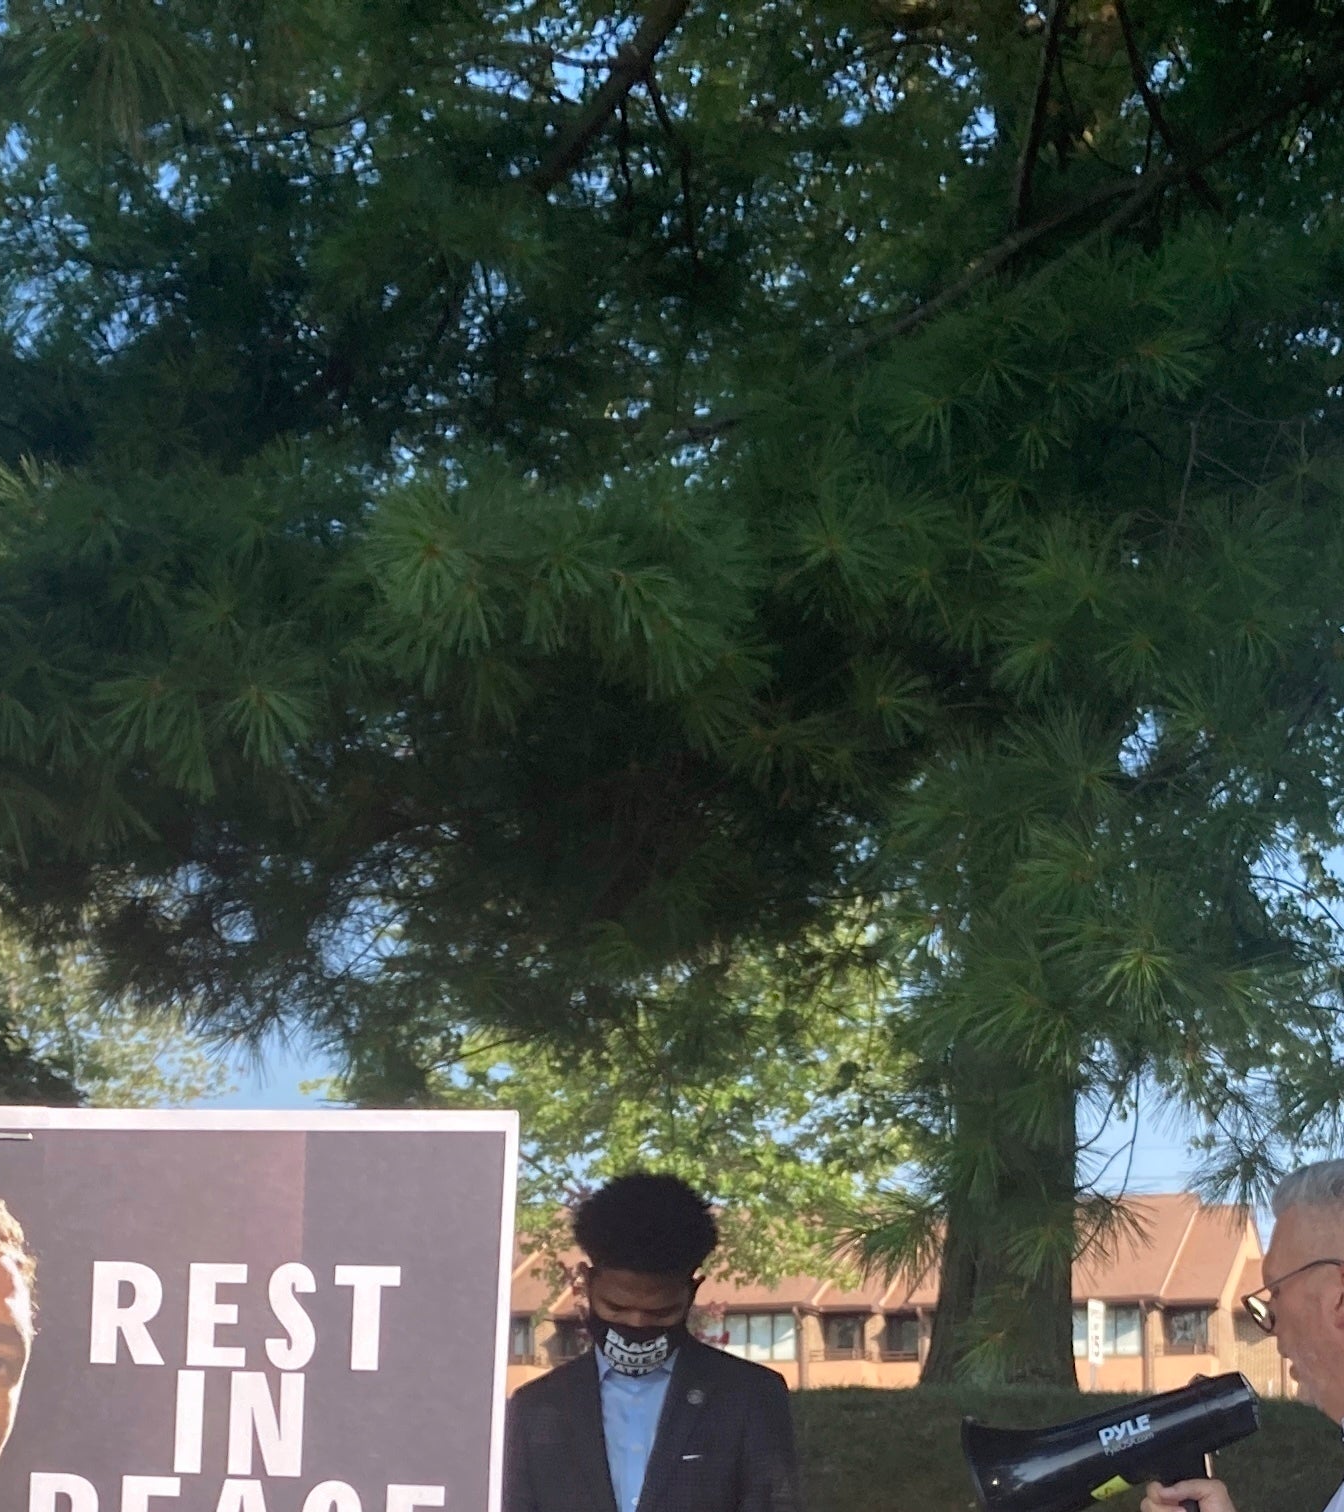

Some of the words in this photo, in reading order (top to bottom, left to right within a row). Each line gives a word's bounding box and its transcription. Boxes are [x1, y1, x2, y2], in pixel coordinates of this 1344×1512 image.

[89, 1260, 401, 1372] REST
[174, 1369, 305, 1478] IN
[1098, 1414, 1151, 1447] PYLE
